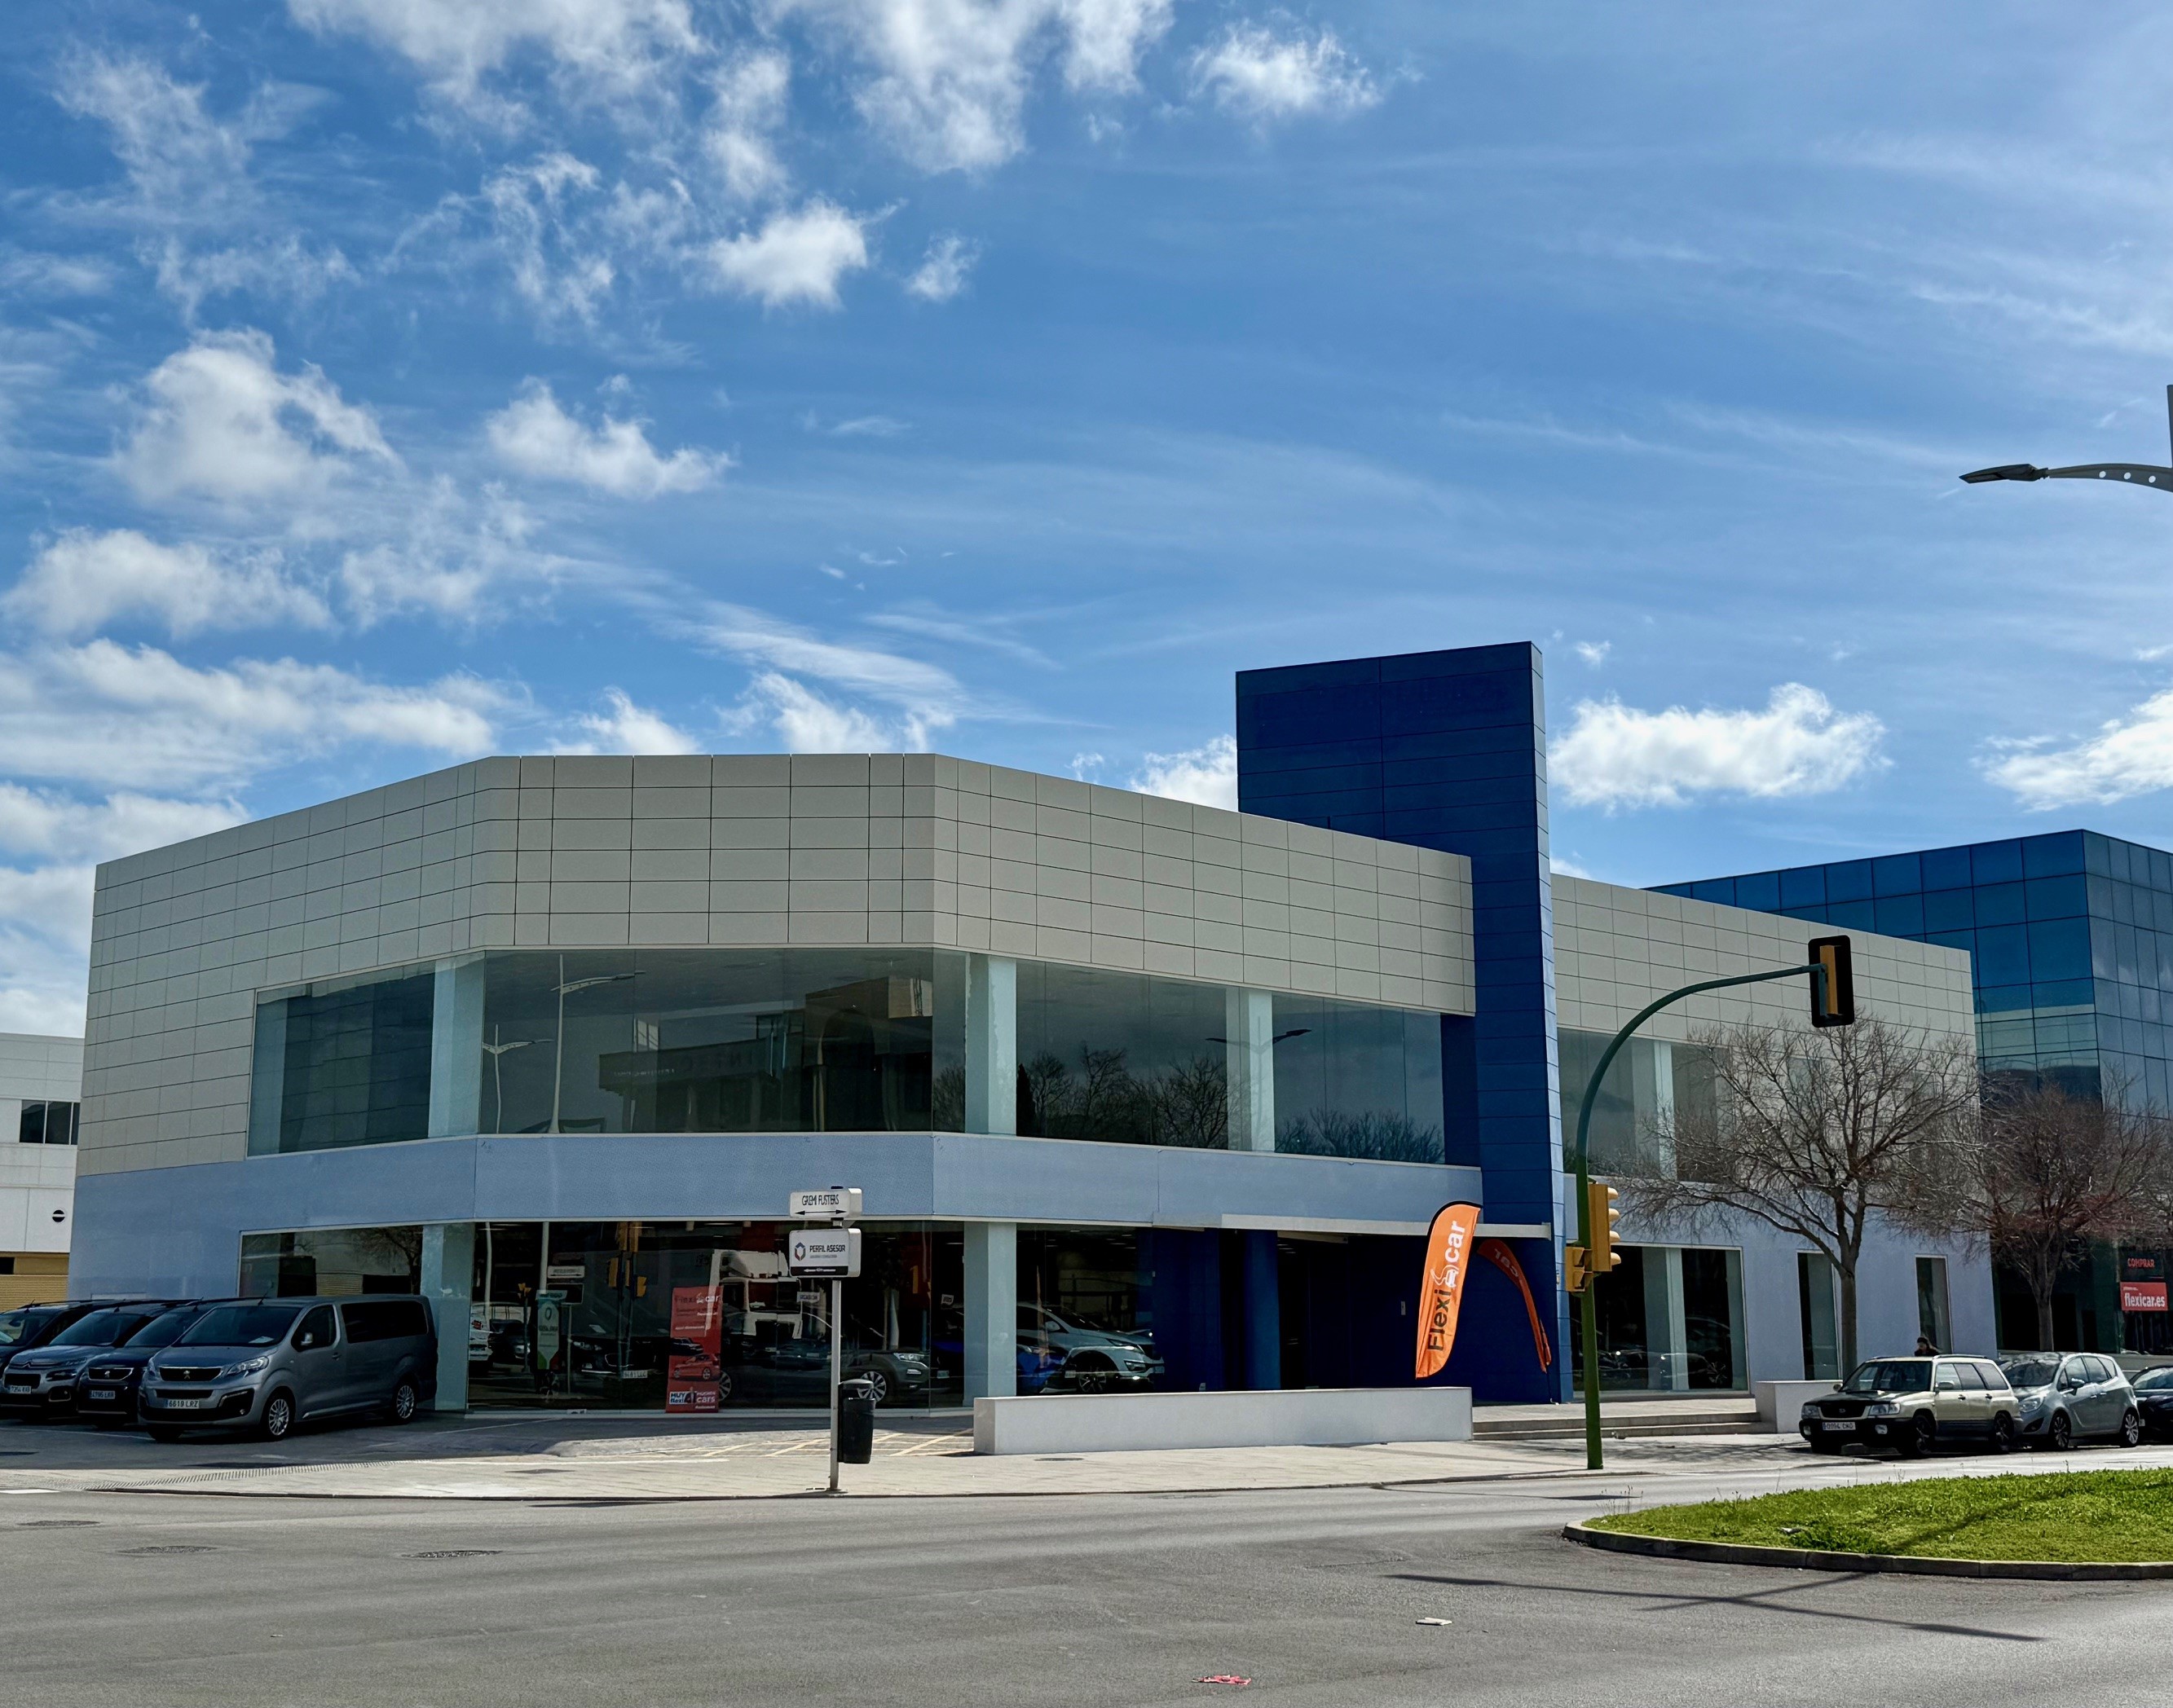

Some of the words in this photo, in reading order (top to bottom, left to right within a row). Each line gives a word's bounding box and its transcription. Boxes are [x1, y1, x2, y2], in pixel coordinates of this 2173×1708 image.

[818, 1194, 840, 1205] FUSTERS
[809, 1244, 826, 1252] PERFIL
[826, 1244, 846, 1252] ASESOR
[2127, 1257, 2155, 1268] COMPRAR
[2124, 1292, 2166, 1307] flexicar.es
